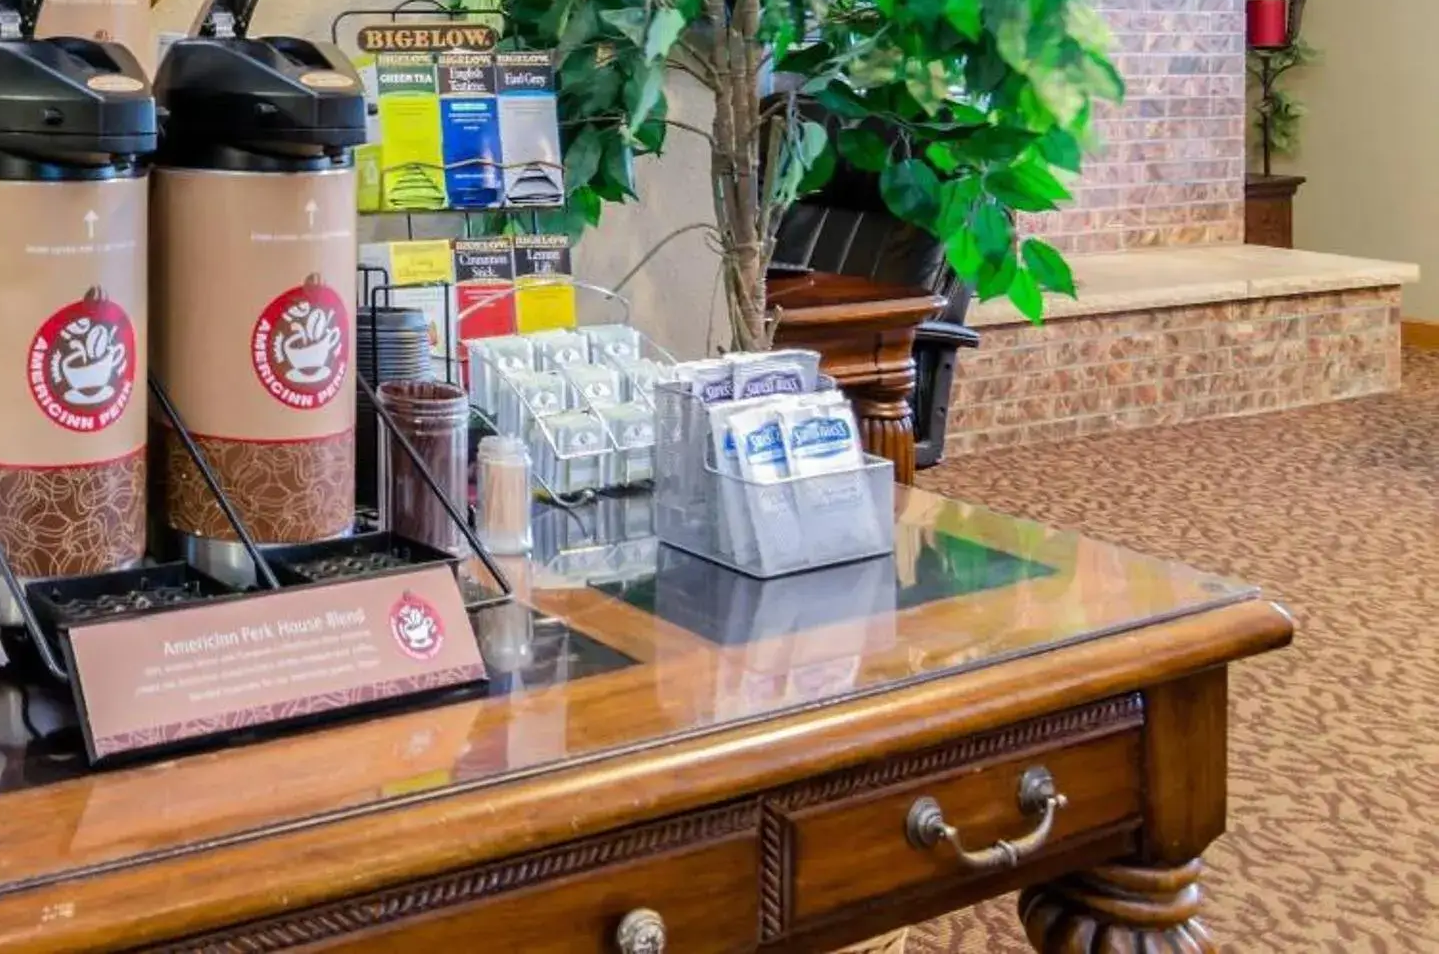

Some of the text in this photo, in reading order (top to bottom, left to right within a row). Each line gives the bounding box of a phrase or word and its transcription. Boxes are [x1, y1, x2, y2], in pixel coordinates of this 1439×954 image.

[365, 29, 490, 47] BIGELOW
[30, 335, 96, 431] AMERICINN
[248, 319, 314, 407] AMERICINN
[241, 623, 274, 643] Perk
[277, 616, 321, 636] House
[325, 607, 366, 629] Blend
